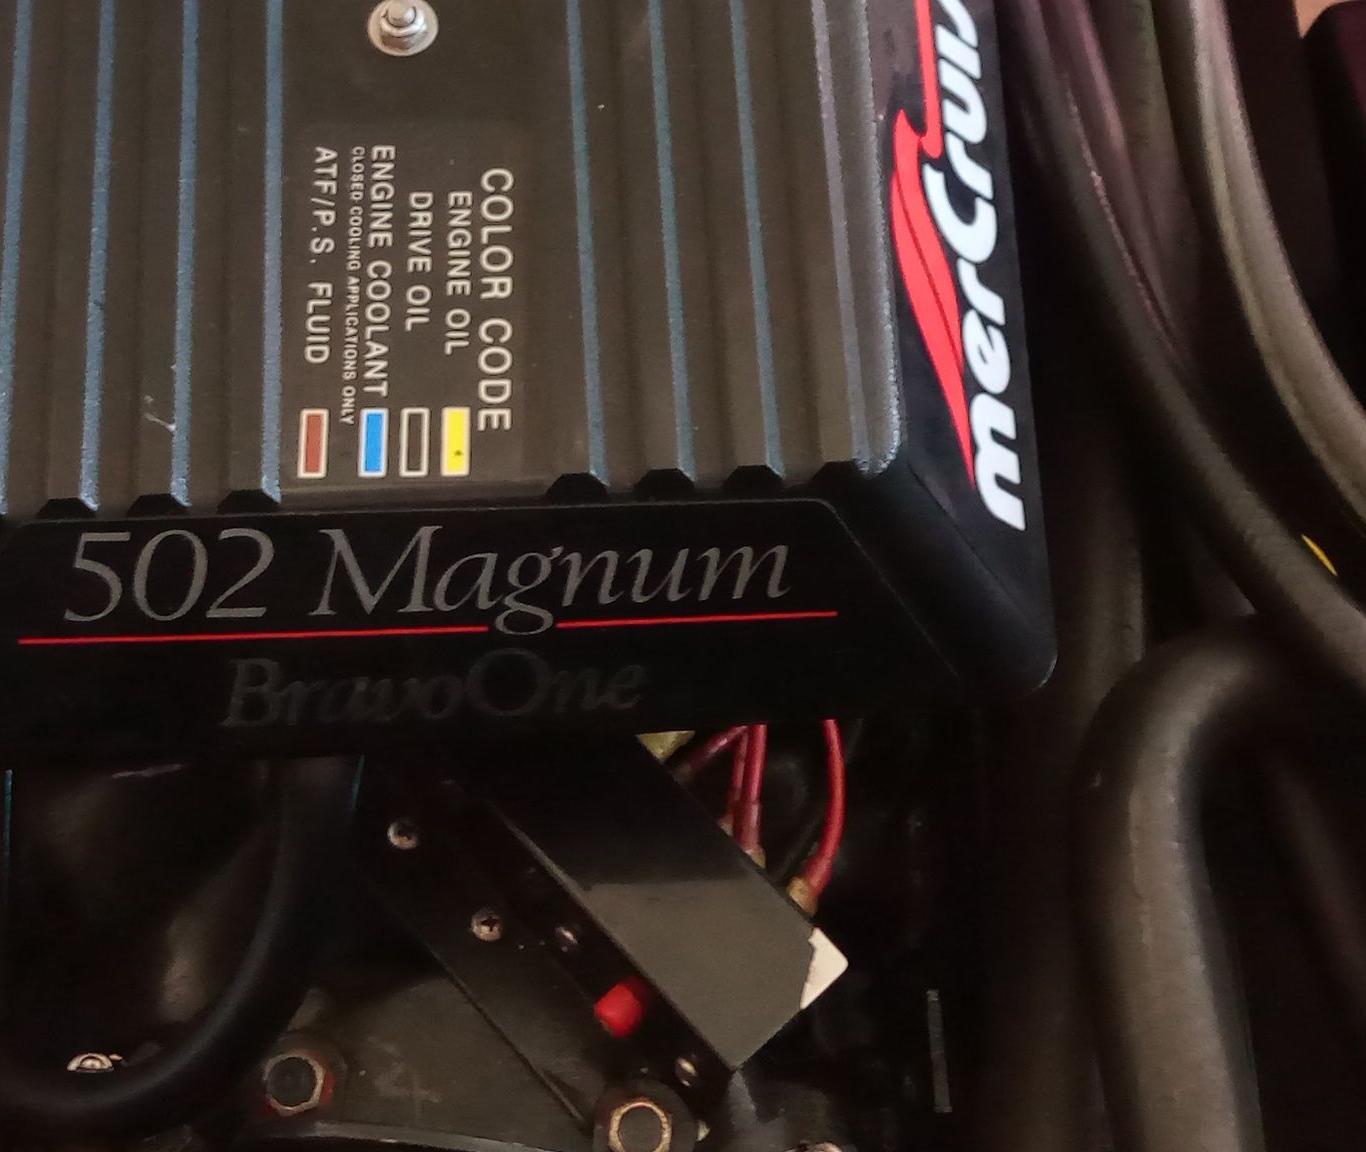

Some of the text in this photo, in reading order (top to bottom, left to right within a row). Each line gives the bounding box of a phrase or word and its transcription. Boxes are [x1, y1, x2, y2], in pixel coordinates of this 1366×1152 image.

[304, 146, 339, 364] ATF/P.S. FLUID
[339, 146, 366, 425] CLOSED COOLING APPLICATIONS ONLY
[363, 144, 396, 397] ENGINE COOLANT
[404, 191, 434, 332] DRIVE OIL
[444, 191, 473, 356] ENGINE OIL
[477, 167, 514, 431] COLOR CODE
[63, 524, 794, 636] 502 Magnum
